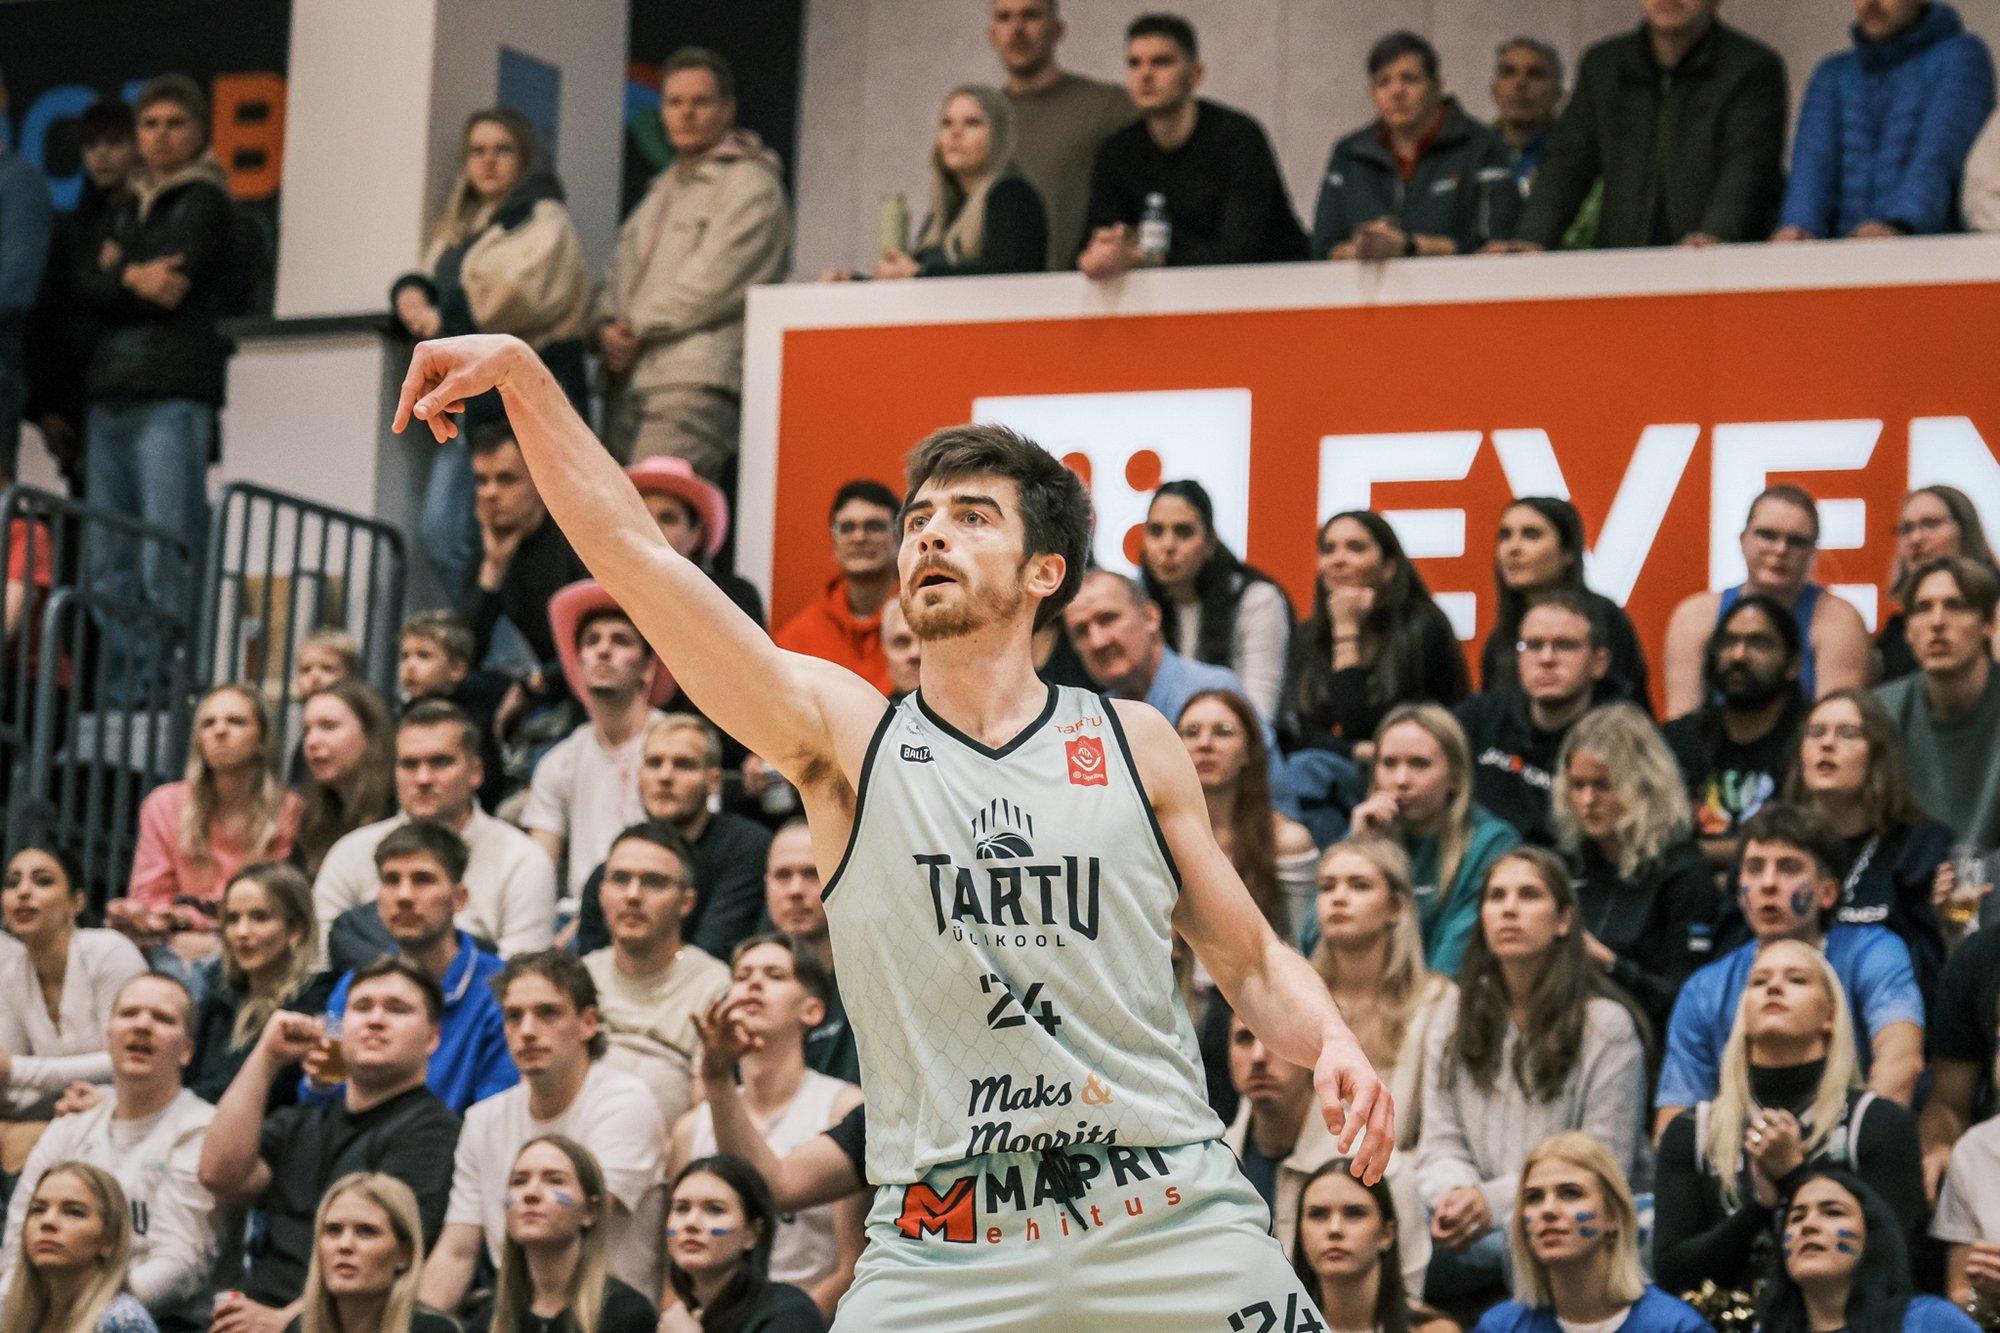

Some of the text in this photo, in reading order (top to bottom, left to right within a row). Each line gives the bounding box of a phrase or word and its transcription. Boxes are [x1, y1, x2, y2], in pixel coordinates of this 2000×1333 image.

[903, 747, 932, 761] BALLZ
[912, 854, 1100, 941] TARTU
[953, 926, 1066, 947] ÜLIKOOL
[979, 973, 1062, 1036] 24
[968, 1072, 1113, 1117] Maks &
[965, 1120, 1117, 1158] Moorits
[985, 1146, 1171, 1213] MAPRI
[986, 1183, 1182, 1244] ehitus
